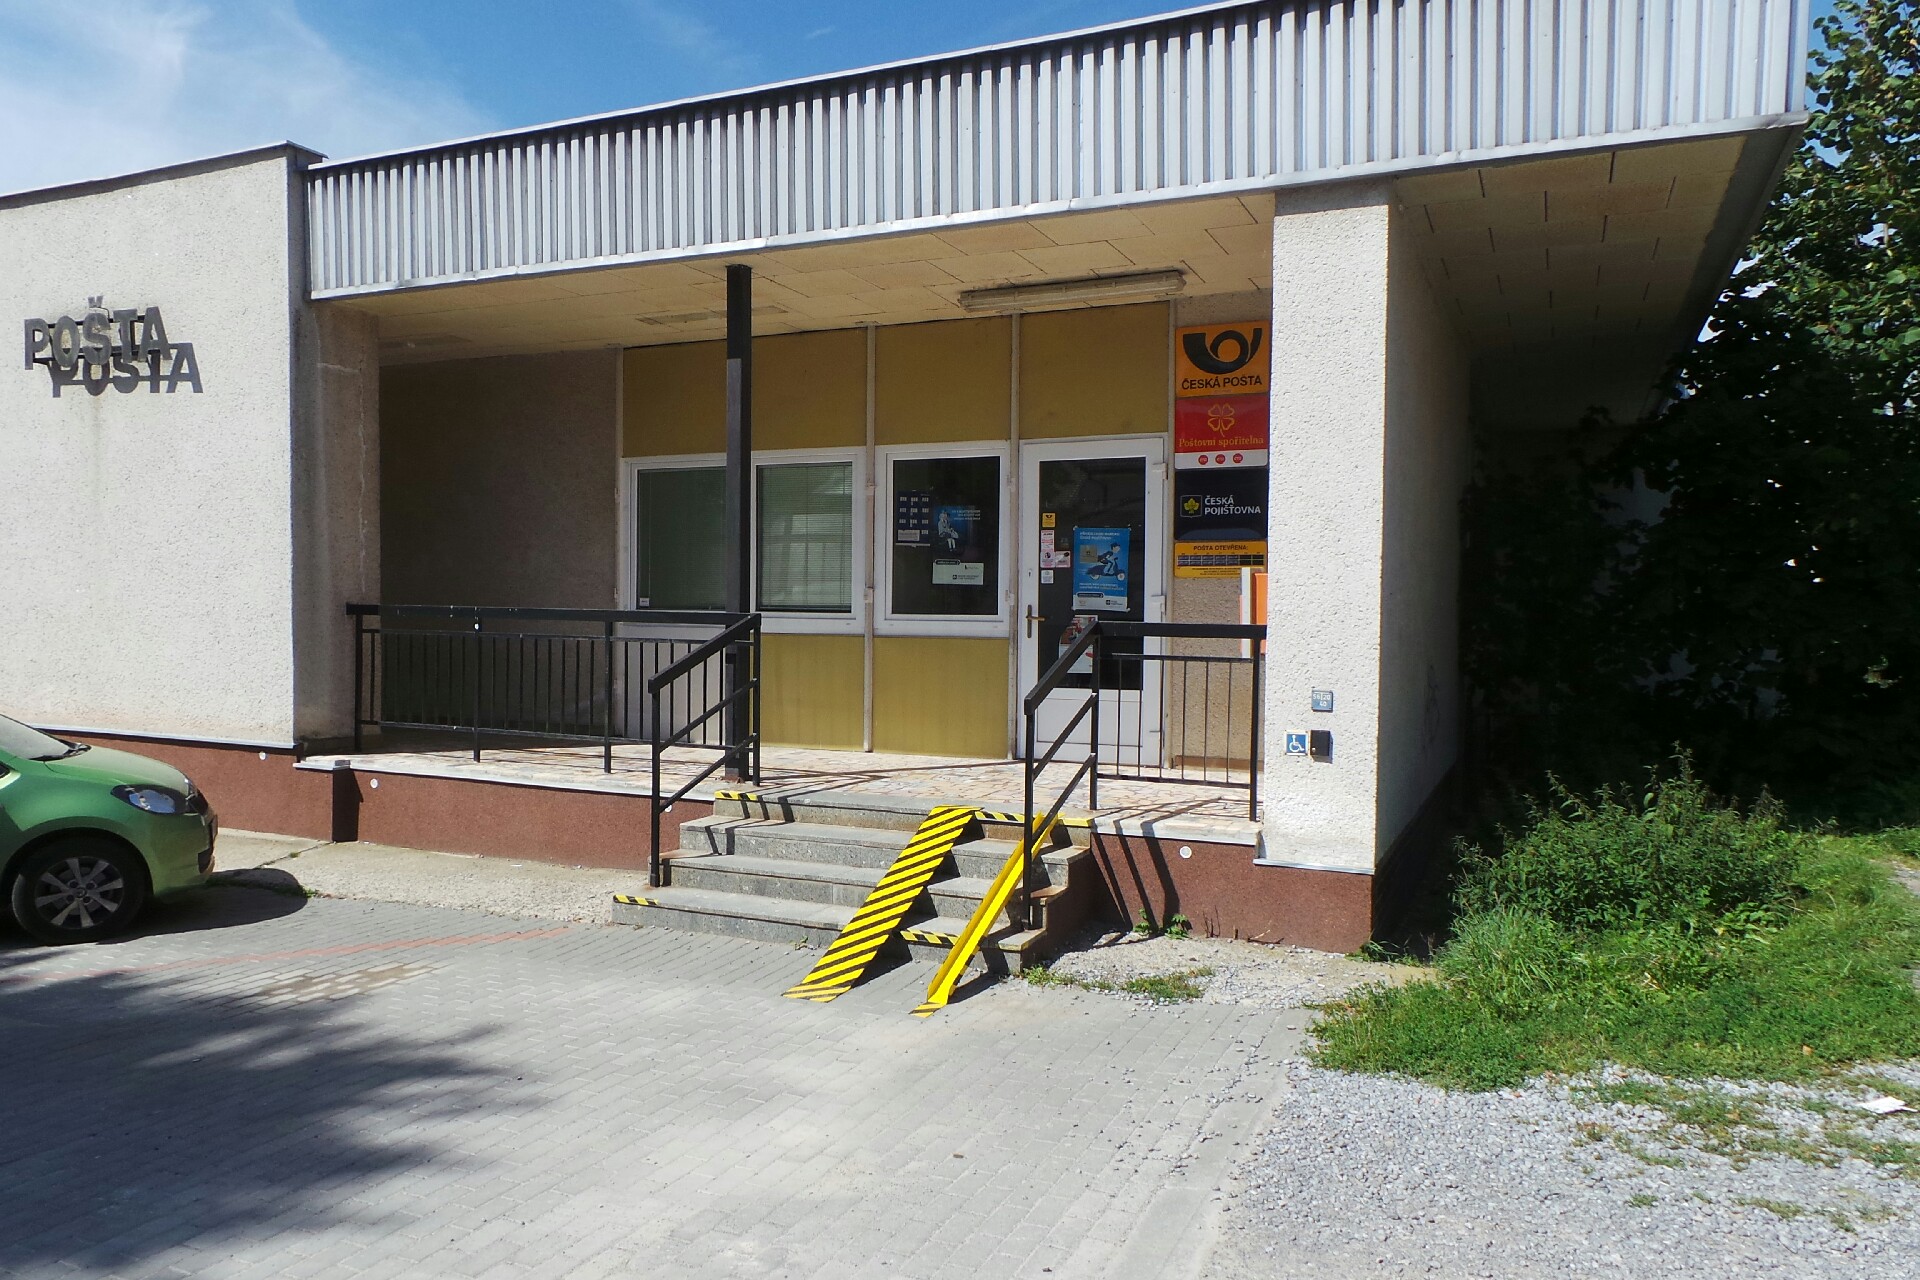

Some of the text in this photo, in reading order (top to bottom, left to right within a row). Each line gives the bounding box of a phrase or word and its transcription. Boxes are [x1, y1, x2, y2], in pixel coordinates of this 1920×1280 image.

[24, 295, 173, 370] POŠTA
[1181, 374, 1263, 390] ČESKÁ POŠTA
[1179, 435, 1264, 447] Poštovní spořitelna
[1204, 495, 1234, 505] ČESKÁ
[1204, 505, 1262, 515] POJIŠŤOVNA
